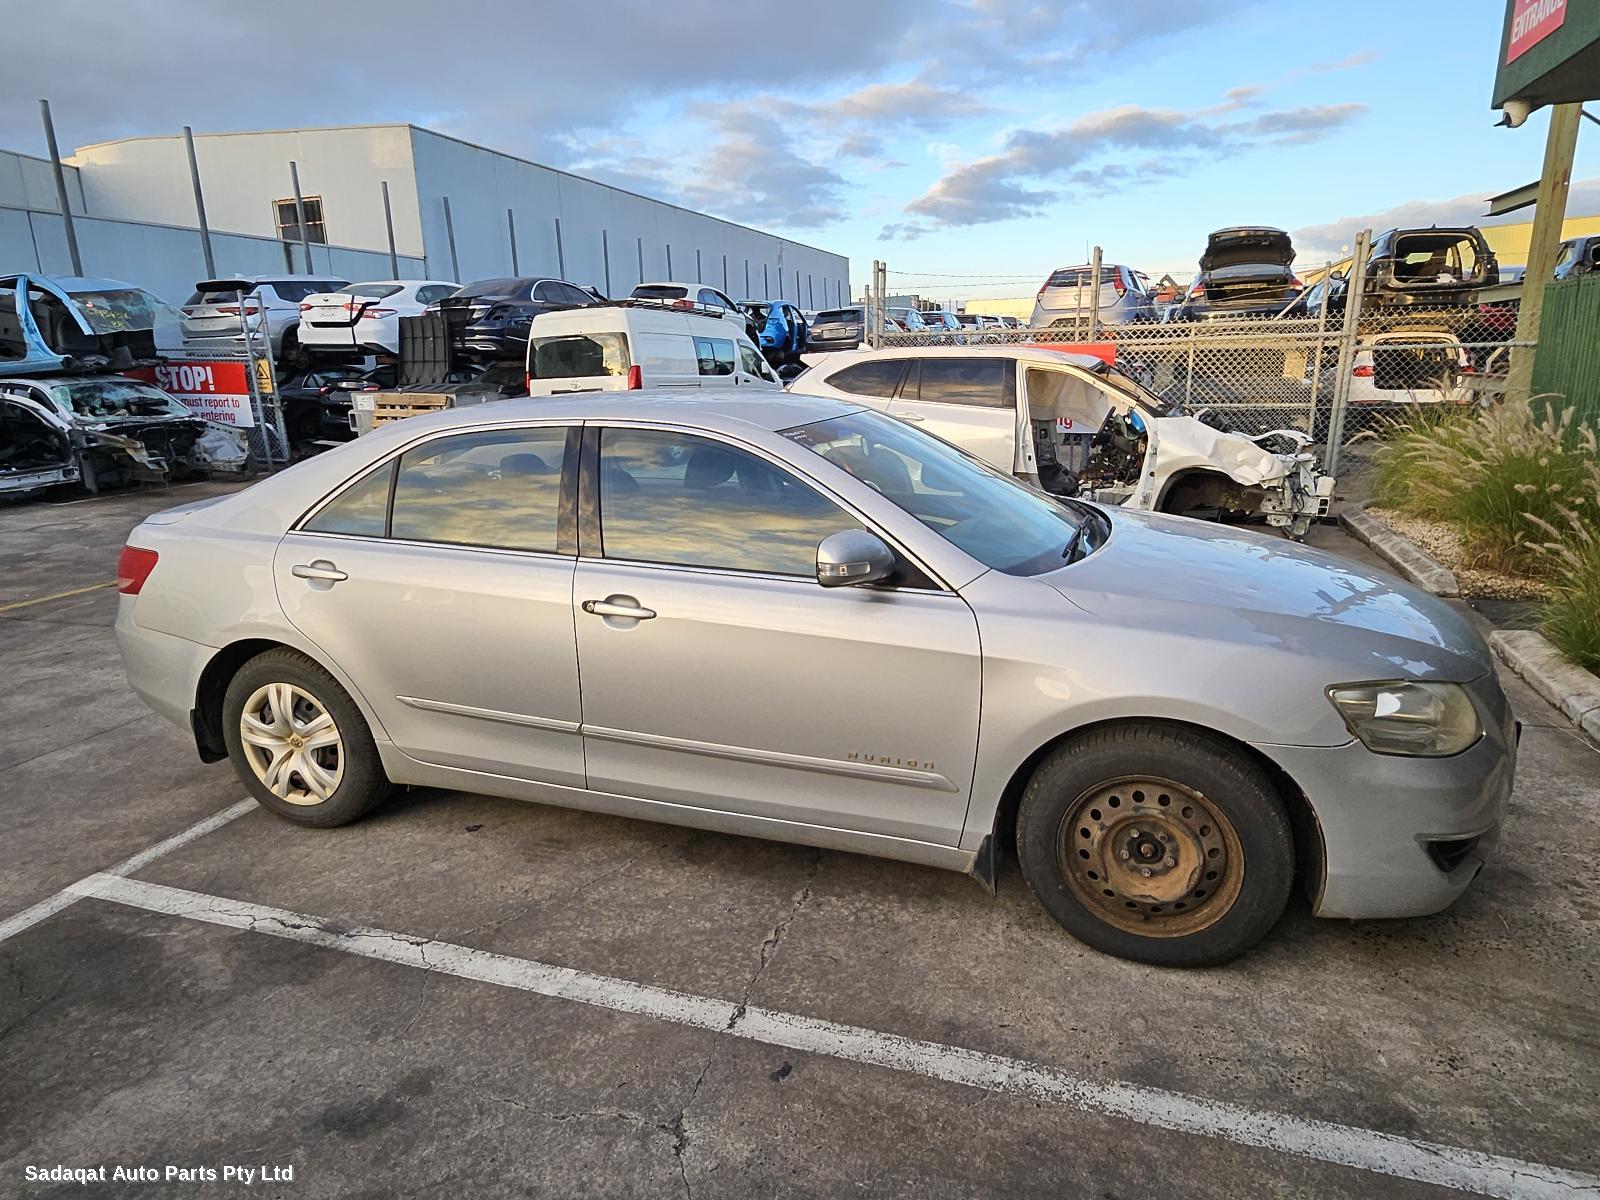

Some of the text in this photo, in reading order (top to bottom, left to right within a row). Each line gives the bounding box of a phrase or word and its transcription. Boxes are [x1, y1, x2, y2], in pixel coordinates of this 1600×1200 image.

[154, 364, 216, 391] STOP!
[205, 397, 231, 410] report
[232, 397, 240, 409] to
[200, 410, 236, 424] entering
